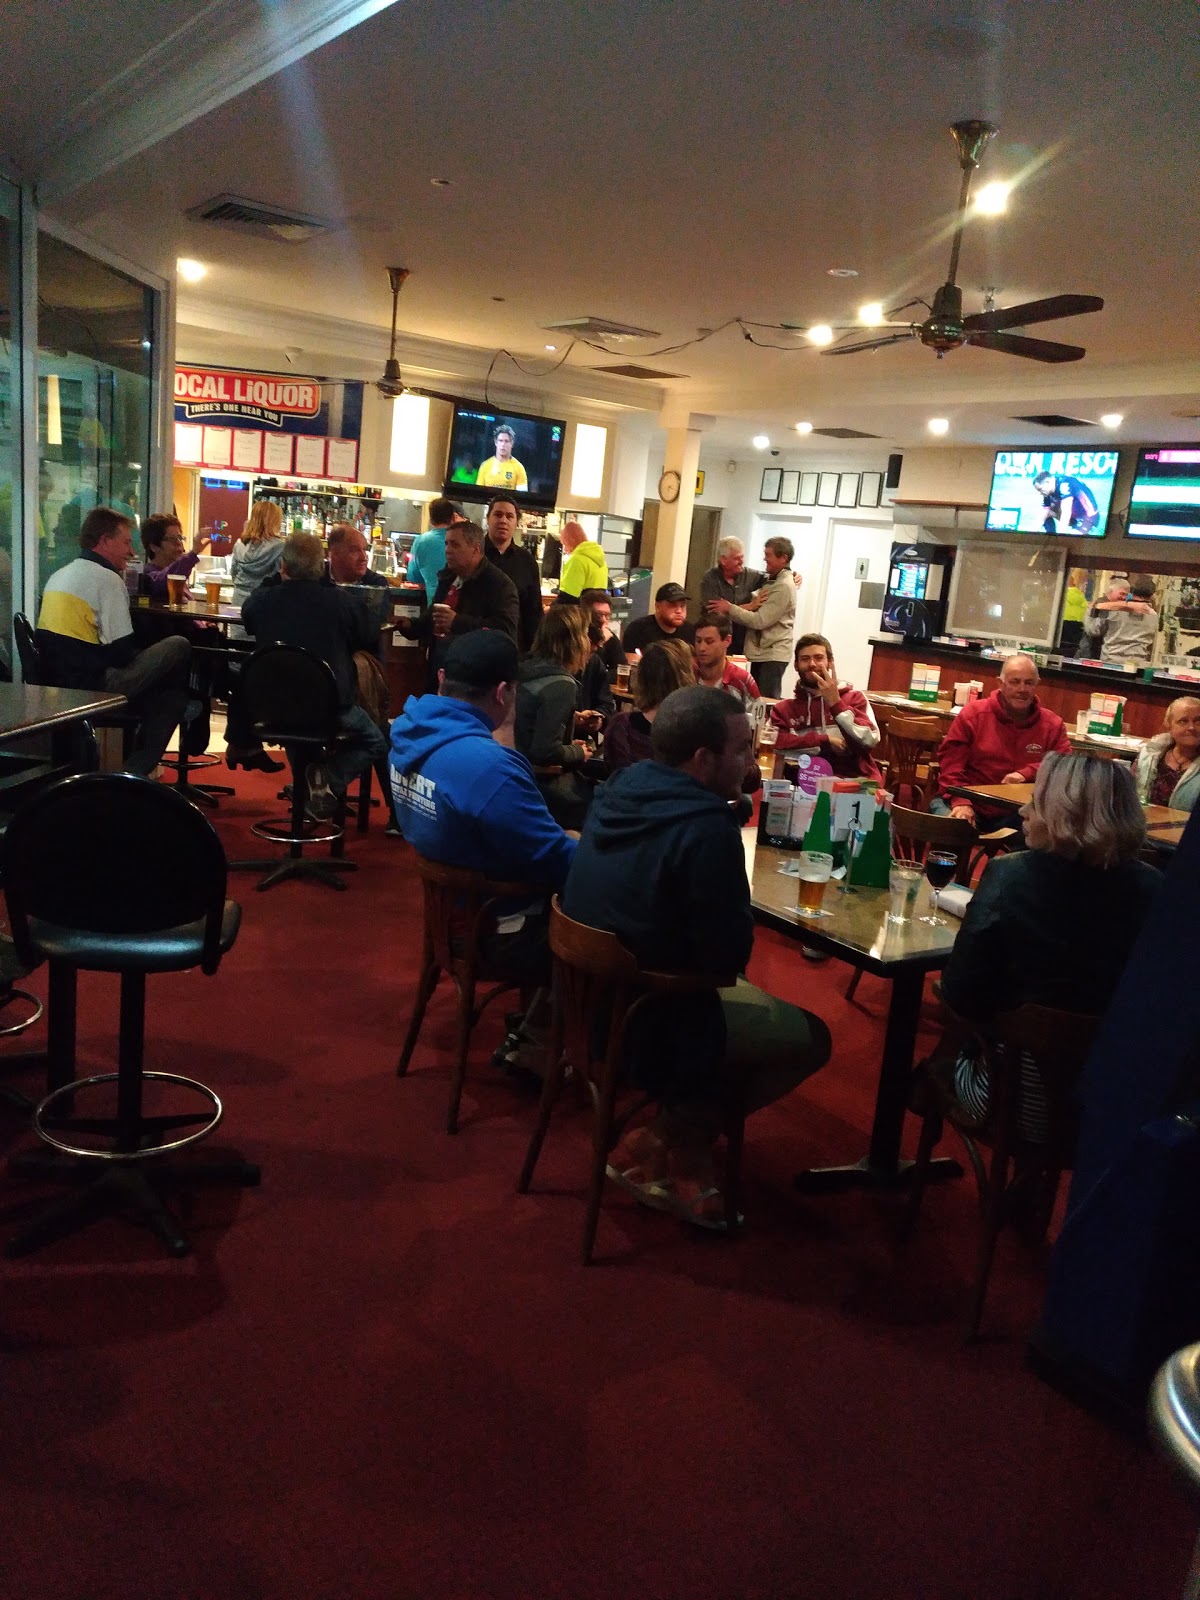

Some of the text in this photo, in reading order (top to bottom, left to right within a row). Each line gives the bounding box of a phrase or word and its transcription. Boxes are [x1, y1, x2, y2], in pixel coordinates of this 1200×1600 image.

[174, 372, 230, 400] OCAL
[190, 402, 278, 422] THERE'S ONE NEAR YOU
[851, 800, 861, 824] 1
